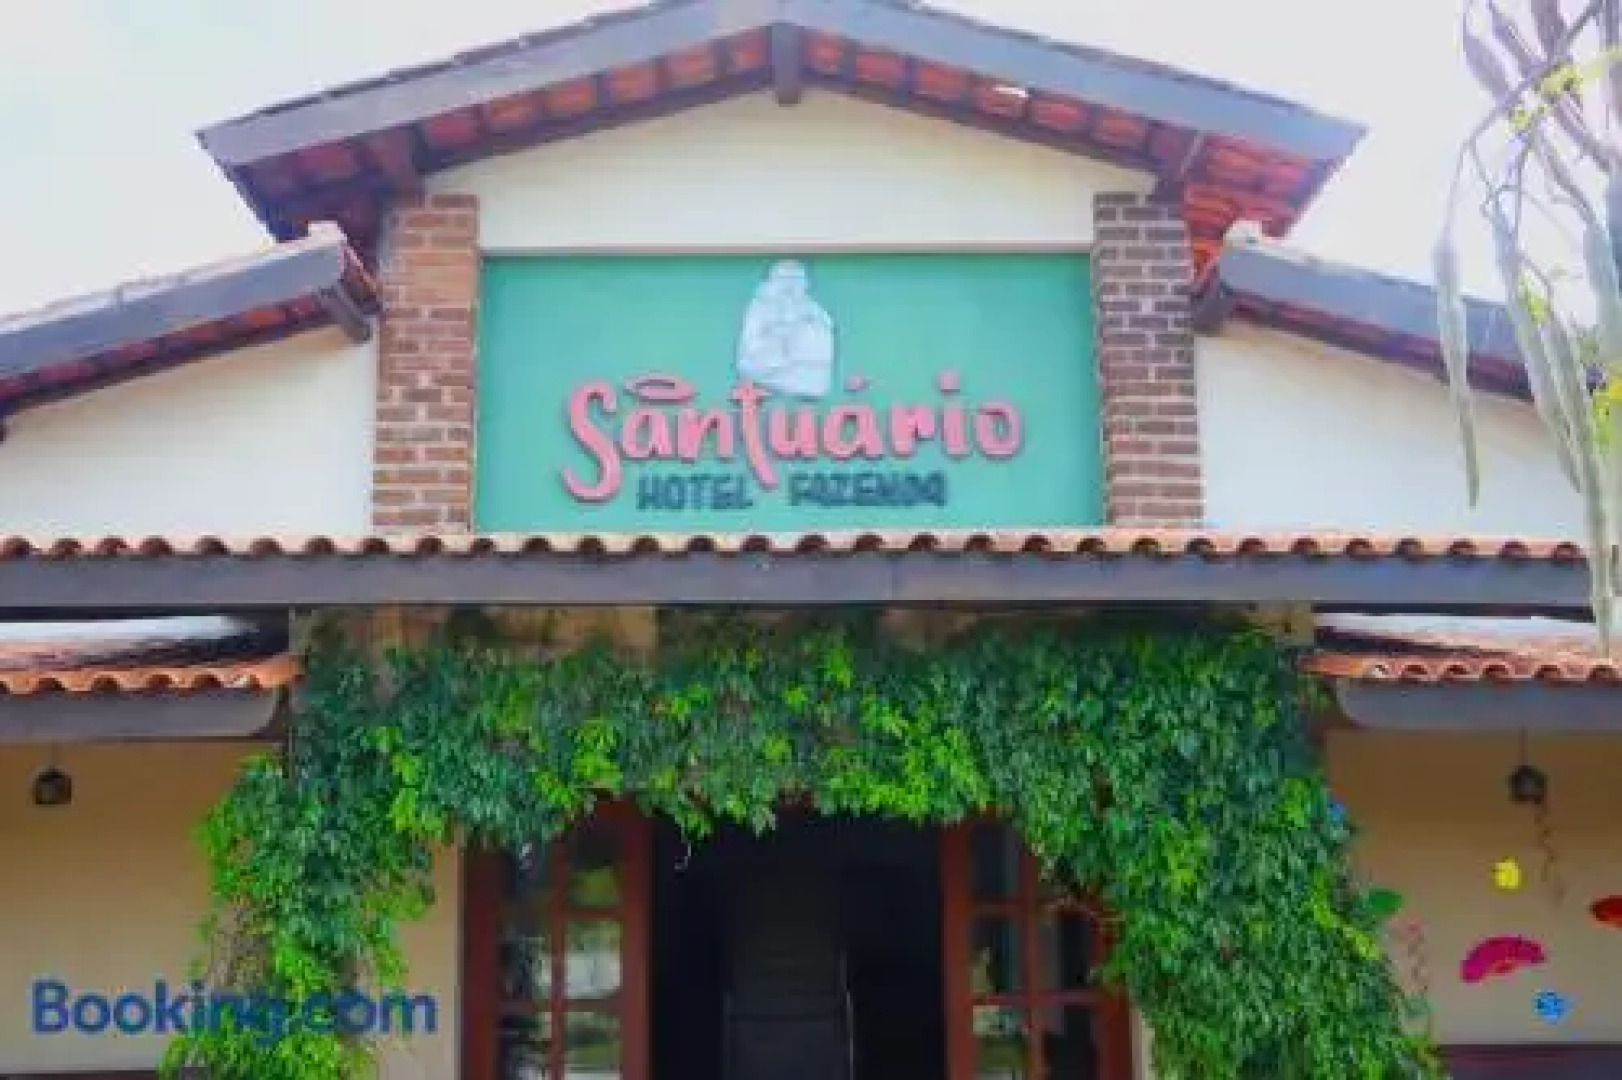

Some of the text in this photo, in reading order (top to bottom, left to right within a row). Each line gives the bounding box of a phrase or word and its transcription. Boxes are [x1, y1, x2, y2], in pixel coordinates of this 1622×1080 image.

[561, 368, 1022, 503] Santuário
[637, 470, 947, 509] HOTEL FAZENDA
